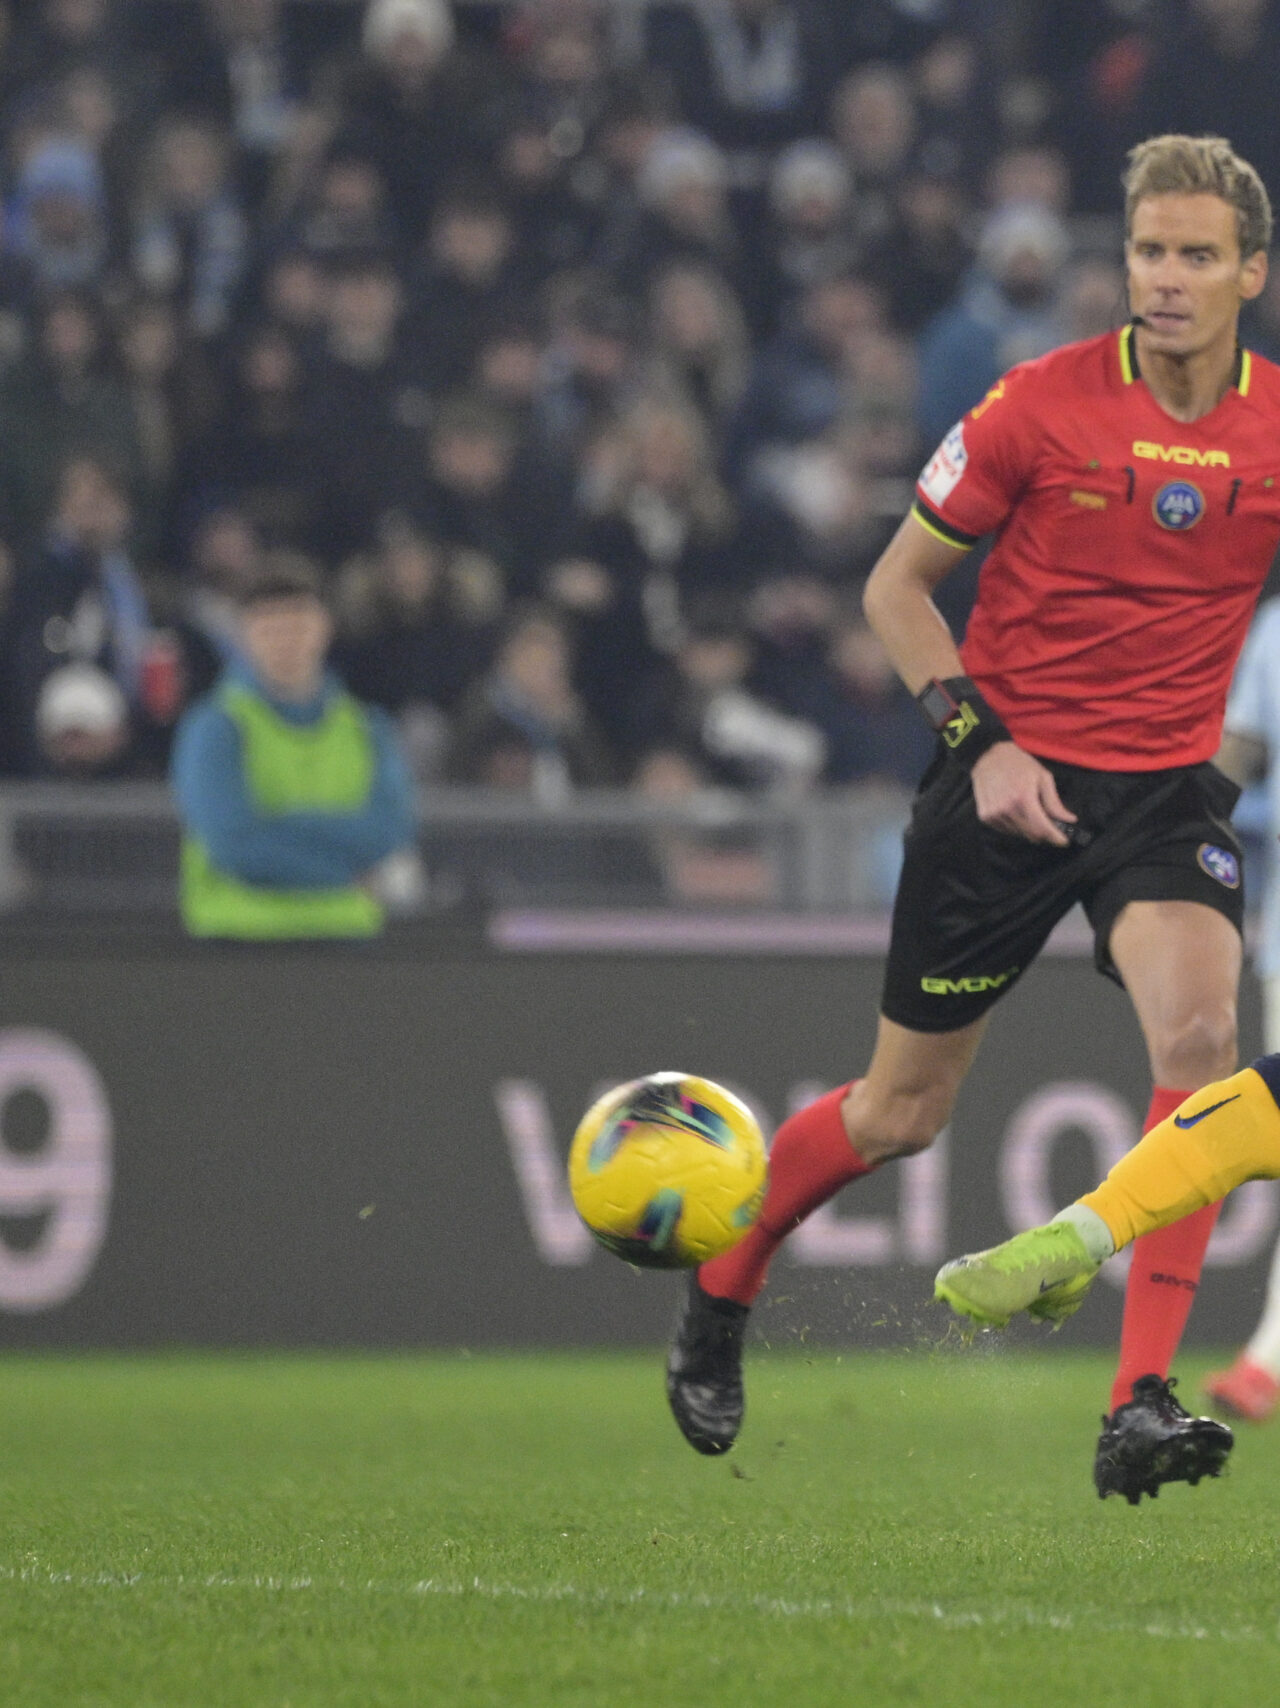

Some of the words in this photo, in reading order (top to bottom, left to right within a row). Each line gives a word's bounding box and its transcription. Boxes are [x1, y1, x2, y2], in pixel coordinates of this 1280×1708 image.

[1133, 440, 1230, 468] GIVOVA
[0, 1030, 112, 1308] 9
[498, 1080, 948, 1264] VLI
